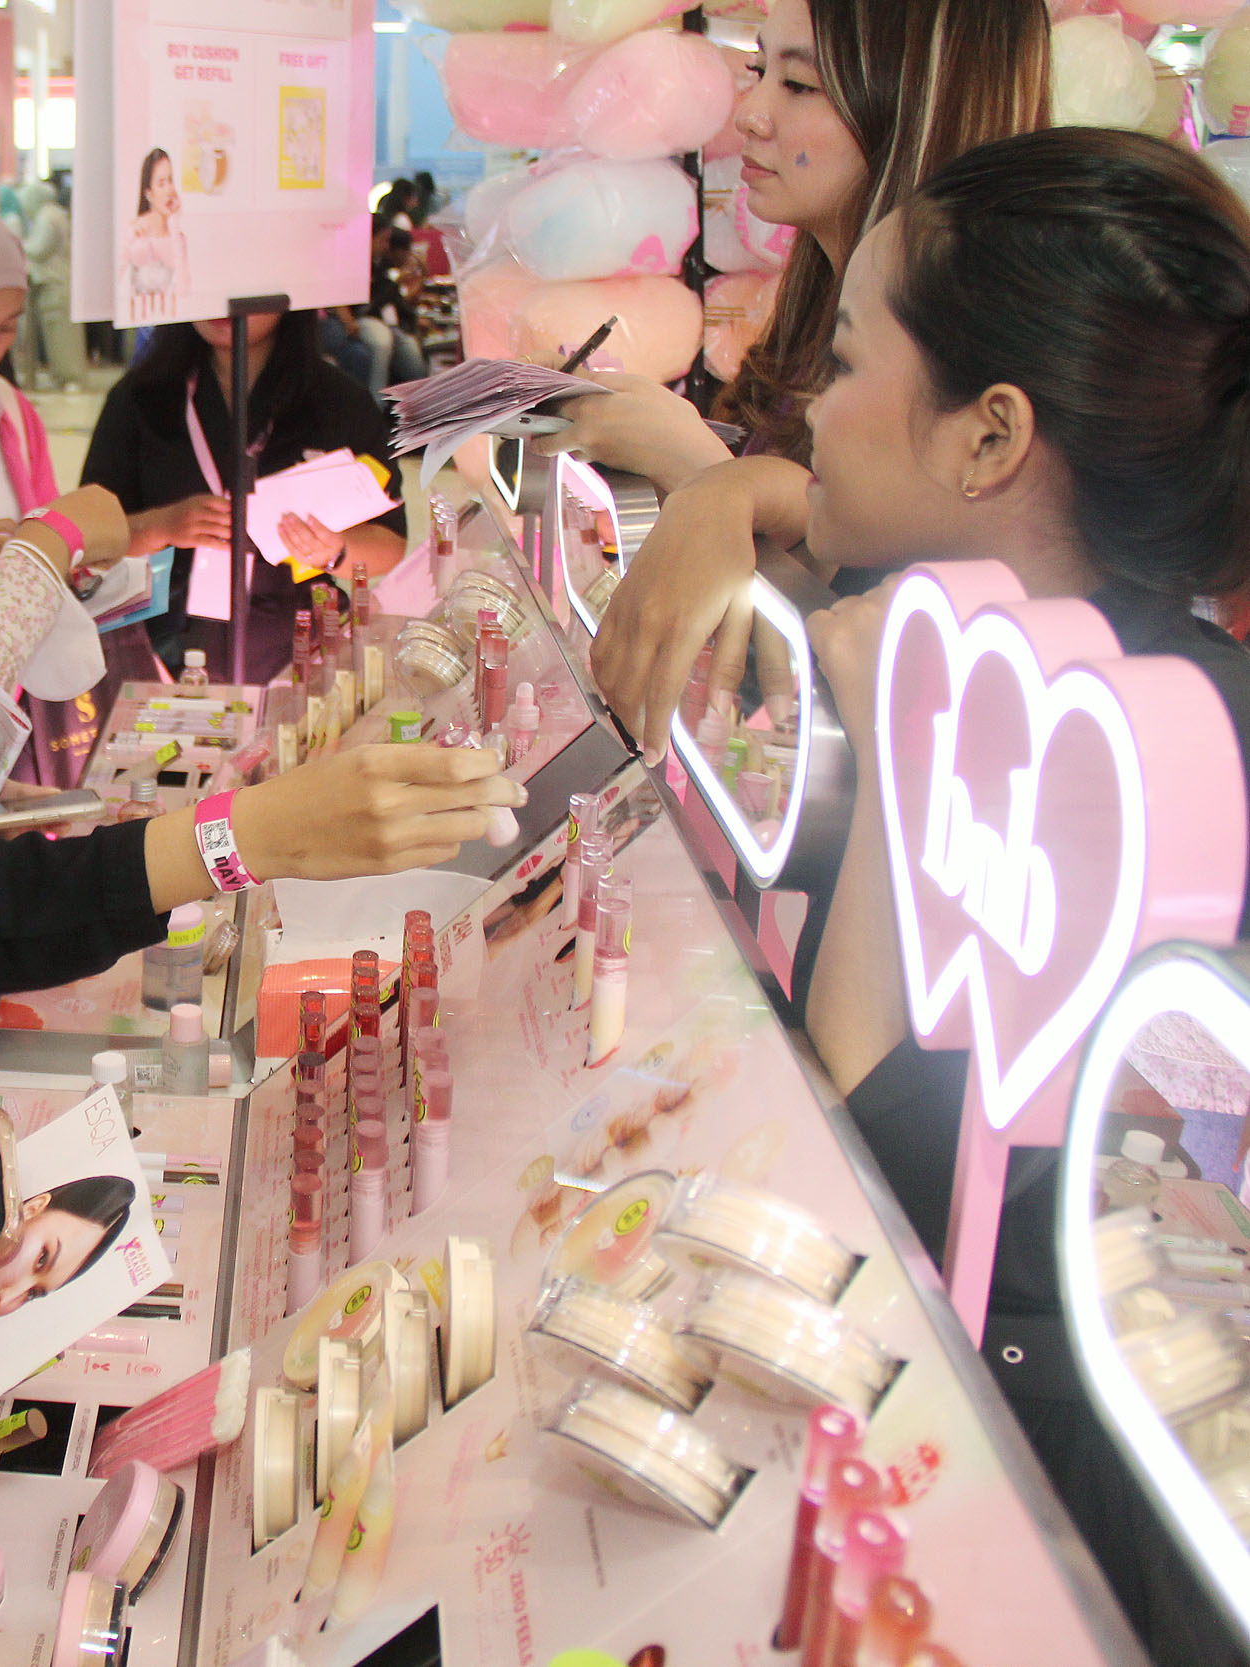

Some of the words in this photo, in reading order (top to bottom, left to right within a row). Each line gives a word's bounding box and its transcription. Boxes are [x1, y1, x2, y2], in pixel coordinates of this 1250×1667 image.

[167, 43, 188, 59] BUY
[192, 45, 240, 61] CUSHION
[279, 53, 304, 68] FREE
[306, 54, 328, 69] GIFT
[174, 65, 195, 80] GET
[197, 67, 233, 82] REFILL
[213, 855, 240, 883] DAY
[83, 1096, 118, 1157] ESQA
[509, 1569, 527, 1613] ZERO
